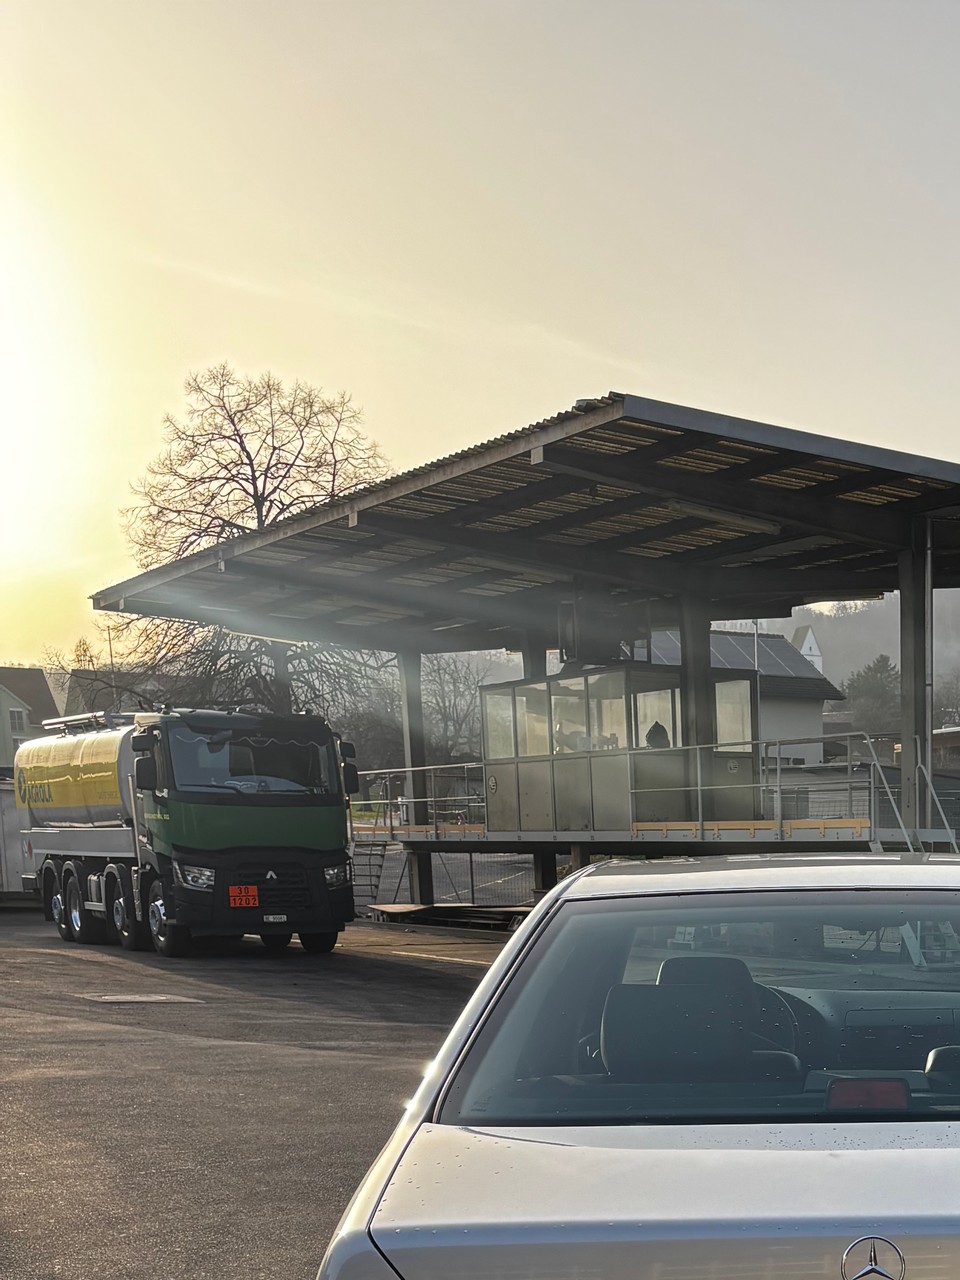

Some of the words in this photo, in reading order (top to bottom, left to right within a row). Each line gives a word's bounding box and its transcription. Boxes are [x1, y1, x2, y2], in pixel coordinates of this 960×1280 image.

[28, 783, 53, 803] AGROLA
[237, 886, 250, 895] 30
[232, 897, 257, 906] 1202
